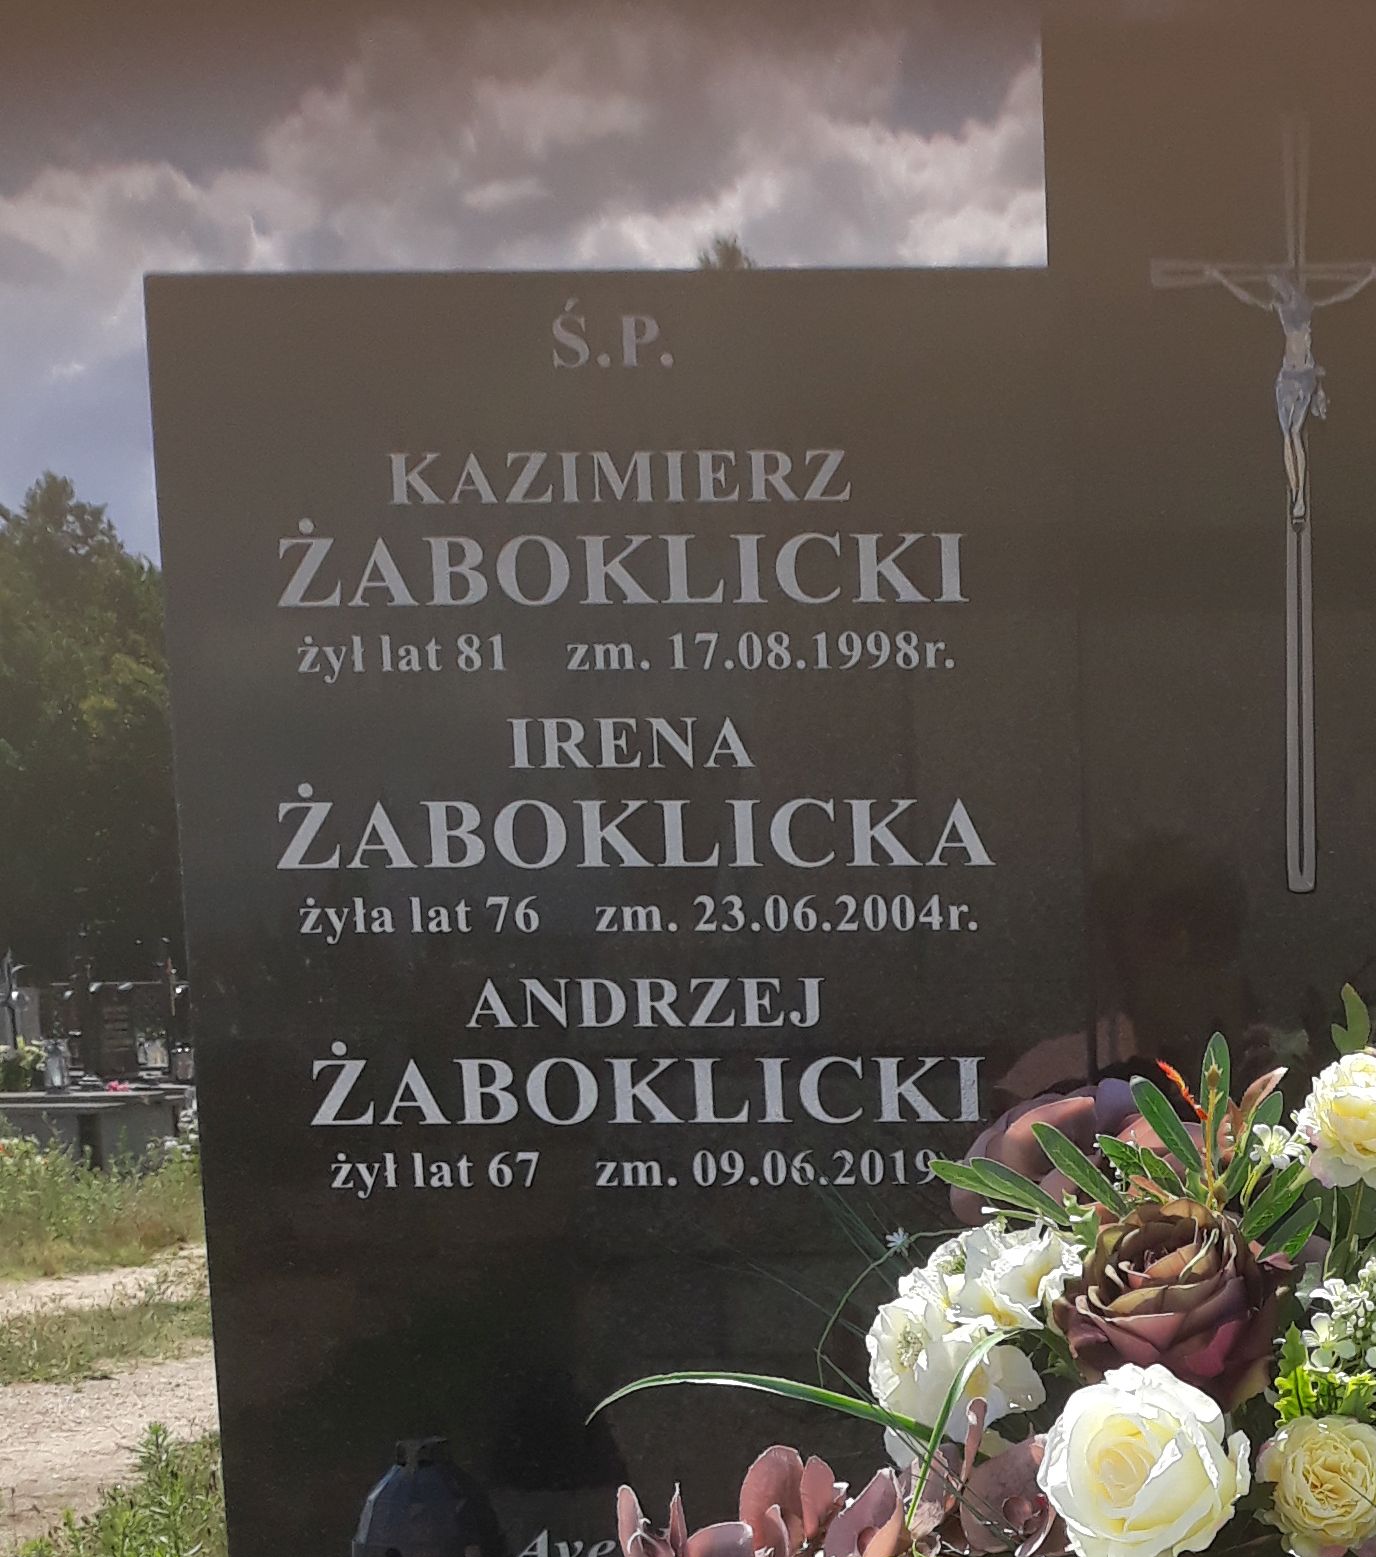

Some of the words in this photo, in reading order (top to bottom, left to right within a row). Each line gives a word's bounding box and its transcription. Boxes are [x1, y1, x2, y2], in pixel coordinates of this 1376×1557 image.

[551, 298, 675, 369] Ś.P.
[389, 449, 852, 506] KAZIMIERZ
[277, 517, 970, 608] ŻABOKLICKI
[297, 634, 366, 684] żył
[380, 634, 442, 673] lat
[457, 633, 508, 673] 81
[566, 642, 651, 671] zm.
[669, 630, 956, 671] 17.08.1998r.
[506, 717, 756, 770] IRENA
[276, 782, 996, 870] ŻABOKLICKA
[298, 897, 395, 943] żyła
[410, 896, 471, 934] lat
[485, 895, 541, 934] 76
[595, 904, 679, 933] zm.
[693, 894, 979, 933] 23.06.2004r.
[465, 977, 825, 1029] ANDRZEJ
[310, 1041, 986, 1128] ŻABOKLICKI
[330, 1151, 399, 1199] żył
[412, 1151, 474, 1189] lat
[488, 1151, 541, 1188] 67
[595, 1159, 679, 1188] zm.
[692, 1148, 952, 1188] 09.06.2019
